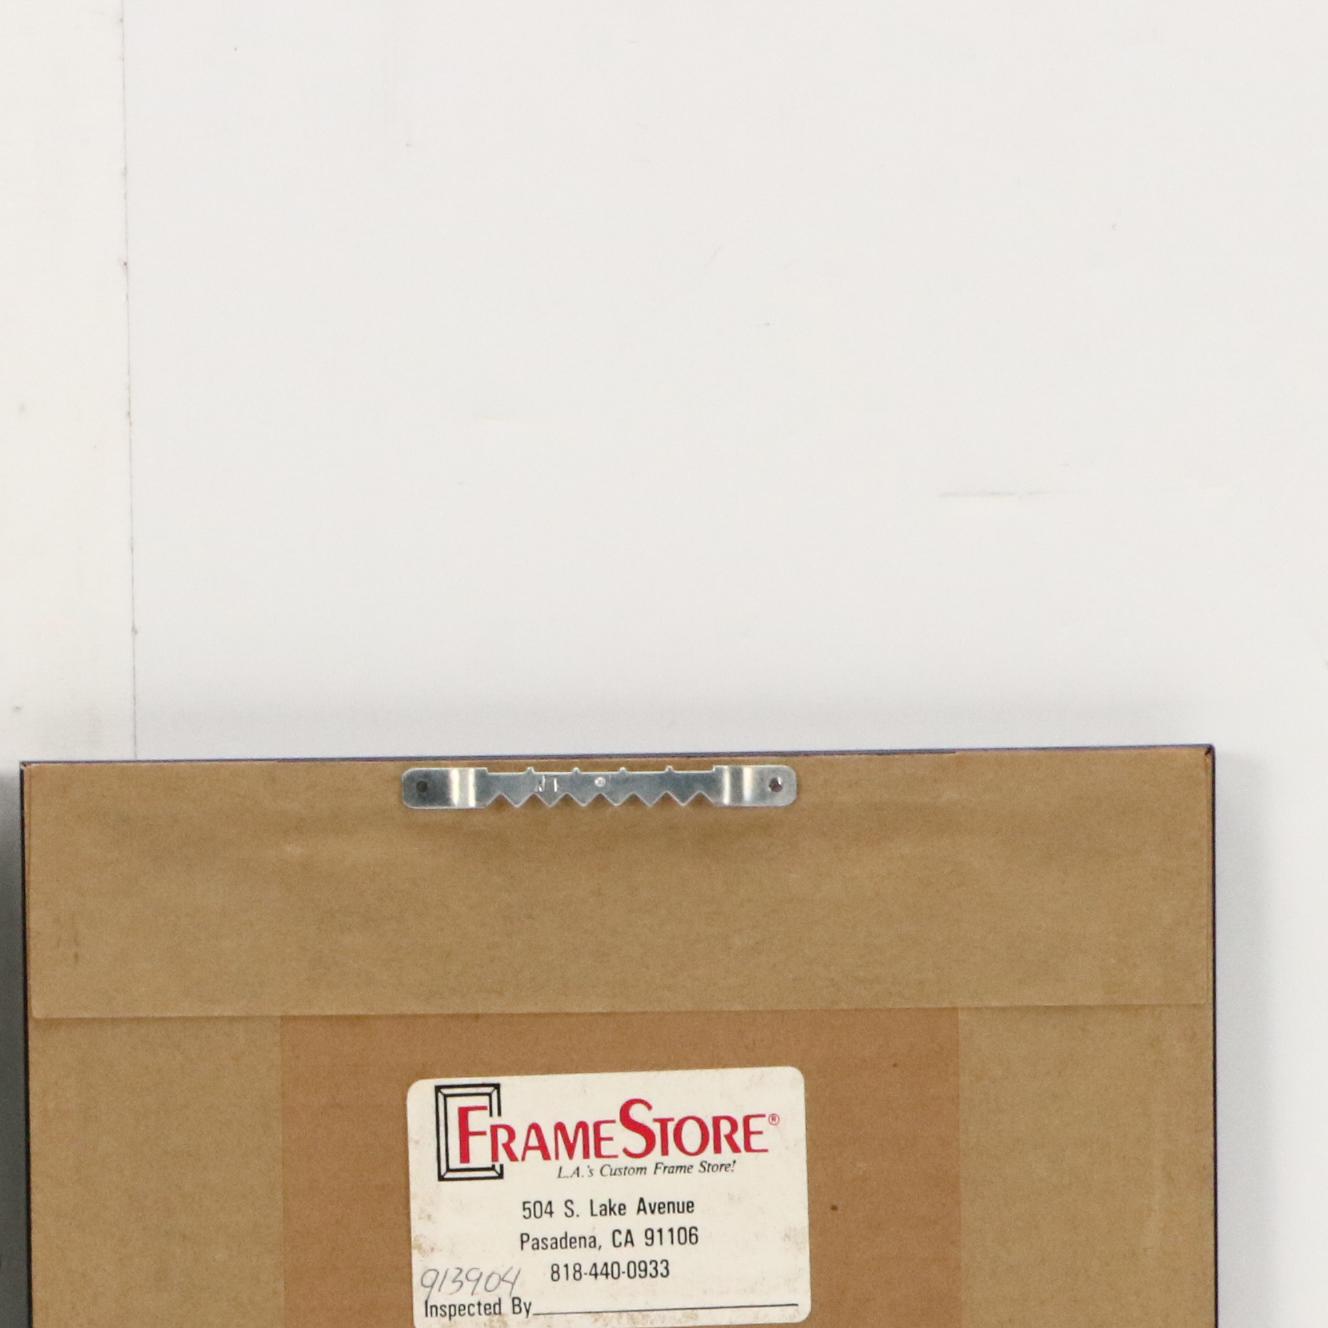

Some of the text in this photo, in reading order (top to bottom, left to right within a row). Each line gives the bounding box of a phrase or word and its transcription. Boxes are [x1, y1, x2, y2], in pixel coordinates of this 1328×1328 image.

[557, 1159, 736, 1179] L.A.'s Custom Frame Store!
[522, 1197, 695, 1219] 504 S. Lake Avenue
[520, 1227, 699, 1251] Pasadena, CA 91106
[550, 1260, 670, 1282] 818-440-0933
[420, 1266, 521, 1300] 913904
[424, 1298, 532, 1319] Inspected By
